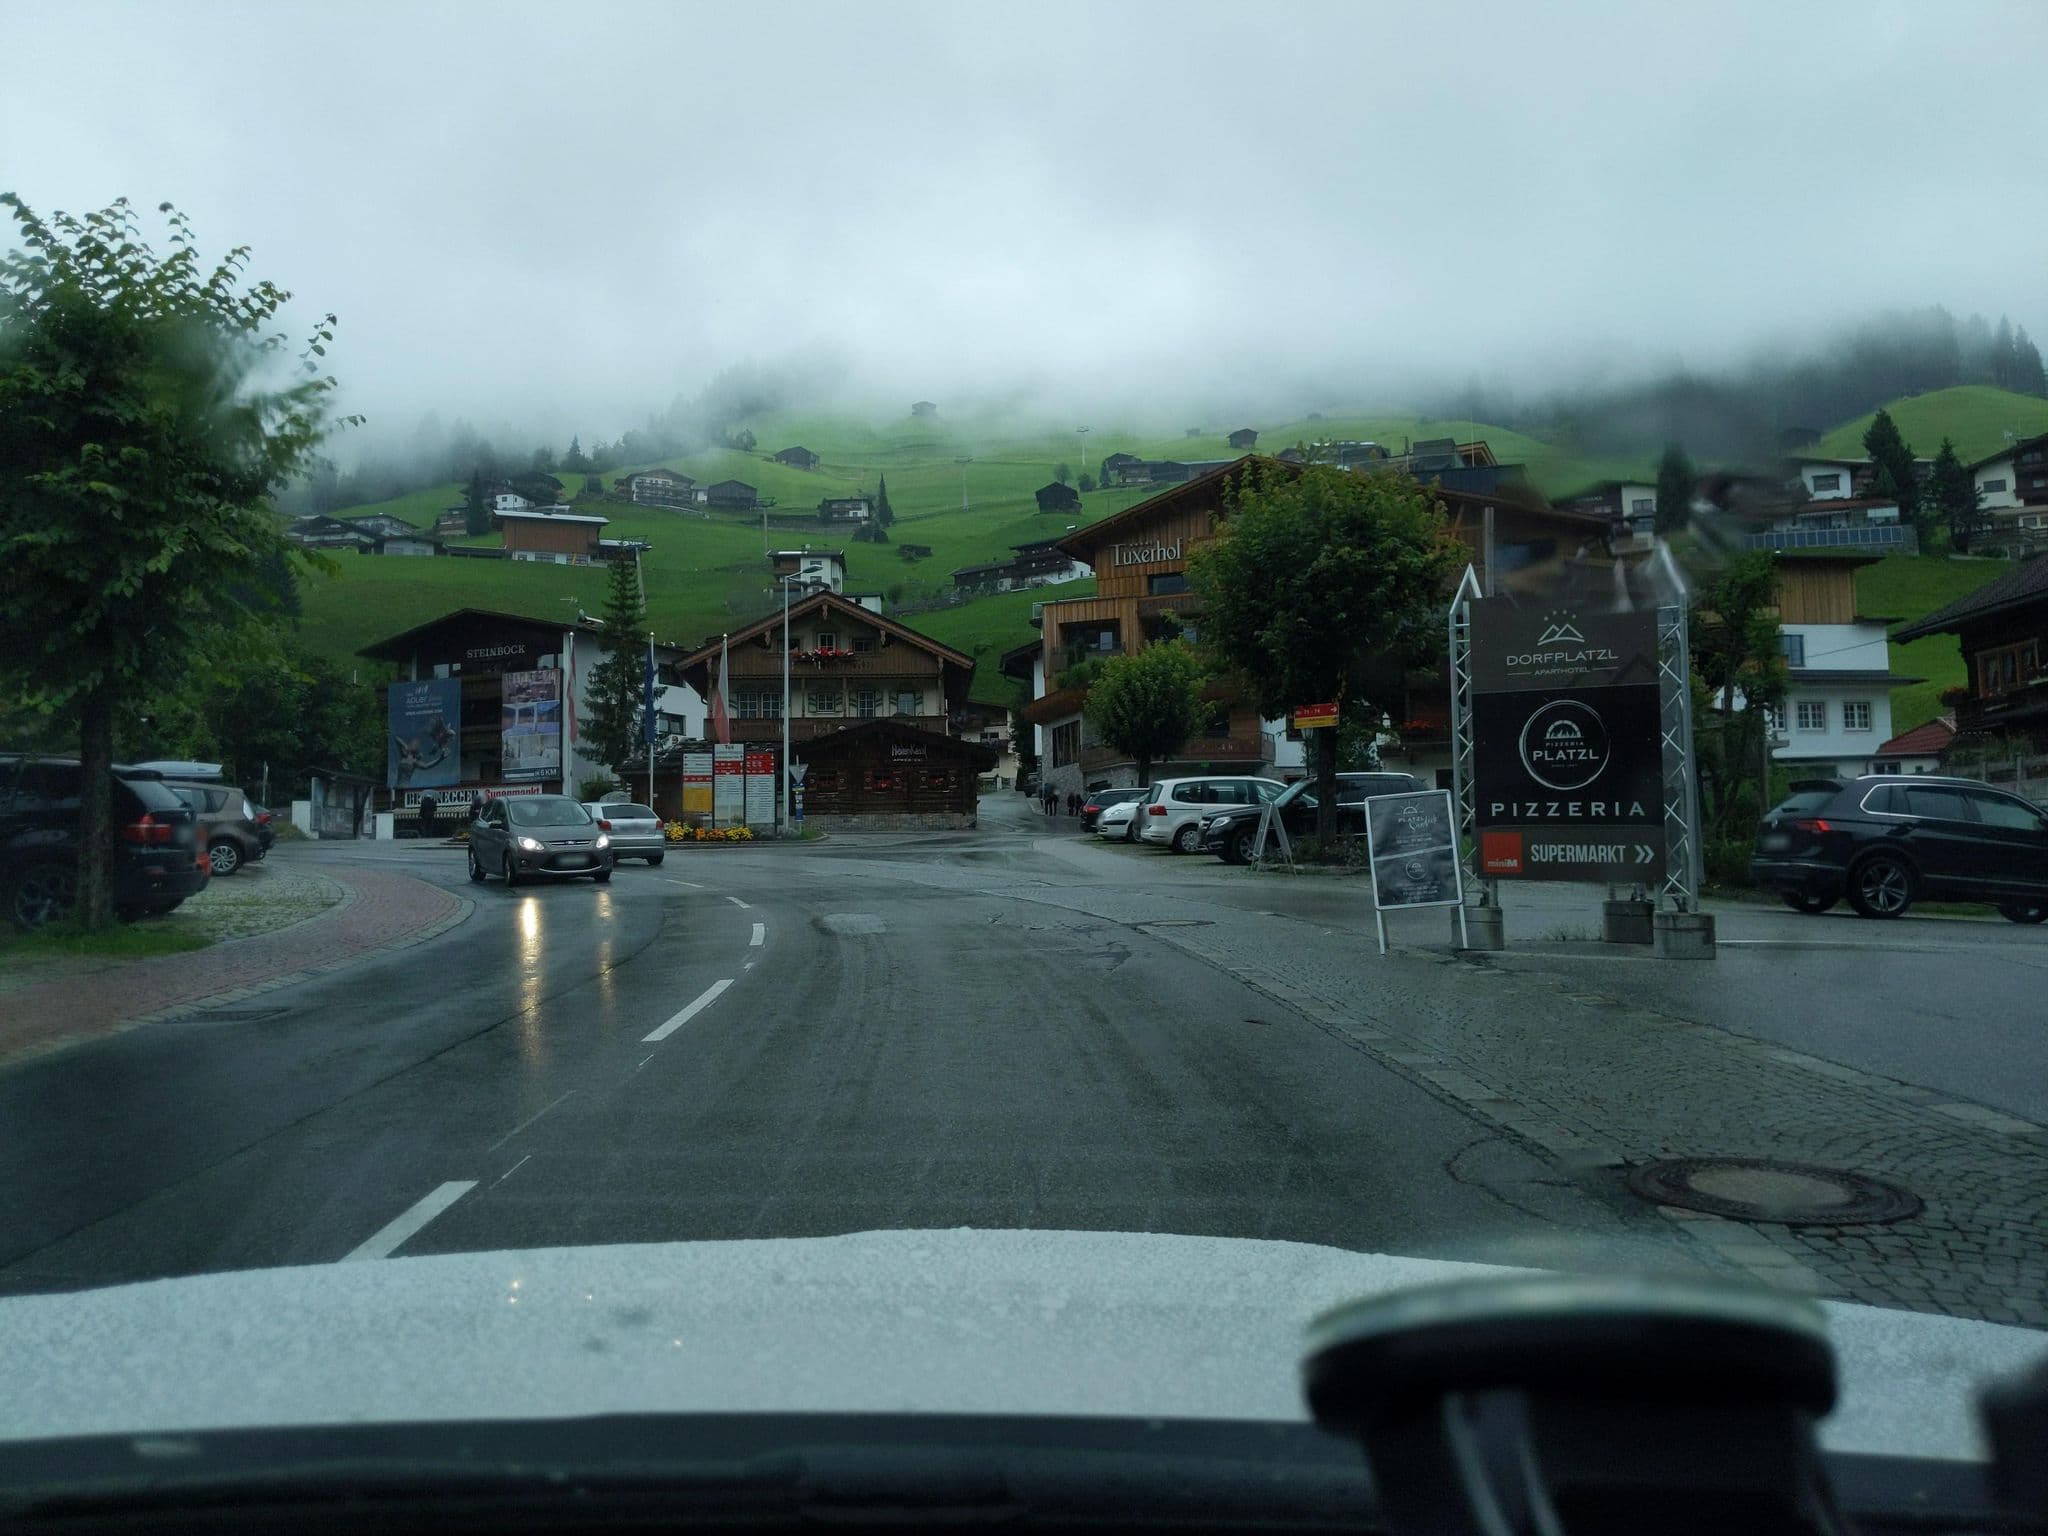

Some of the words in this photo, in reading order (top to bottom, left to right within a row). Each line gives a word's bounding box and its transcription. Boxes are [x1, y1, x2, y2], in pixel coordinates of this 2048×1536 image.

[1107, 537, 1184, 566] Tuxerhof
[467, 645, 526, 659] STEINBOCK
[1506, 649, 1619, 666] DORFPLATZL
[1534, 667, 1591, 676] APARTHOTEL
[1532, 749, 1600, 761] PLATZL
[406, 790, 479, 805] BRNEGGER
[1491, 801, 1646, 817] PIZZERIA
[1530, 844, 1627, 863] SUPERMARKT
